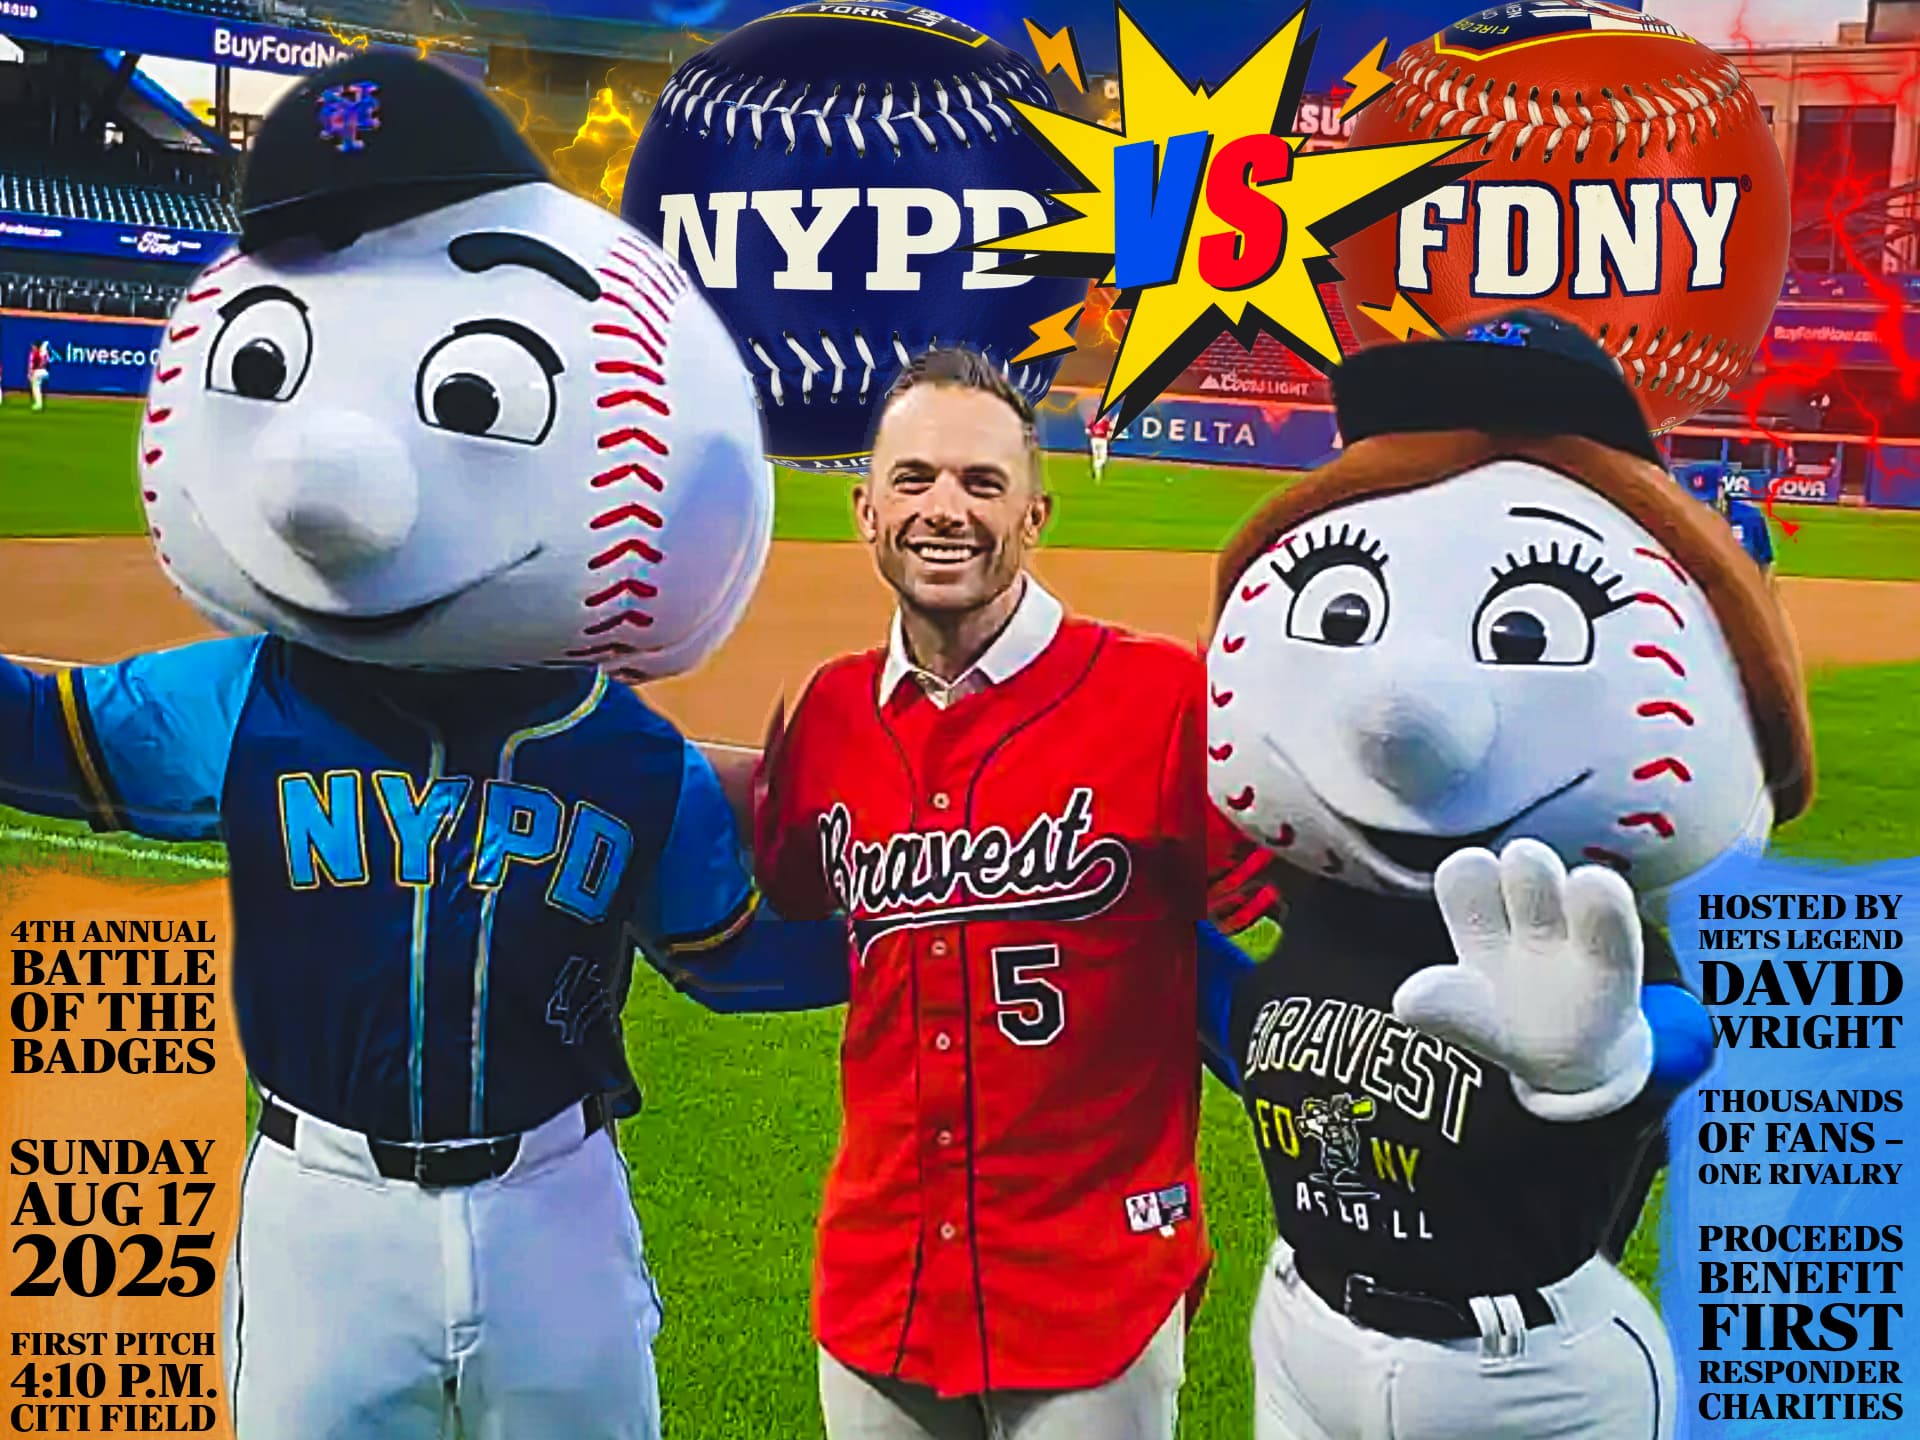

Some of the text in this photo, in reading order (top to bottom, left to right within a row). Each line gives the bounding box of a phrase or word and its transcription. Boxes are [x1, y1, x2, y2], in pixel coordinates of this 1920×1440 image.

[818, 5, 889, 19] YORK
[659, 187, 1049, 291] NYPD
[1394, 176, 1741, 299] FDNY
[67, 342, 146, 366] Invesco
[1142, 416, 1256, 447] DELTA
[278, 769, 635, 925] NYPD
[819, 788, 1131, 930] Bravest
[991, 944, 1064, 1046] 5
[1256, 1098, 1299, 1159] FD
